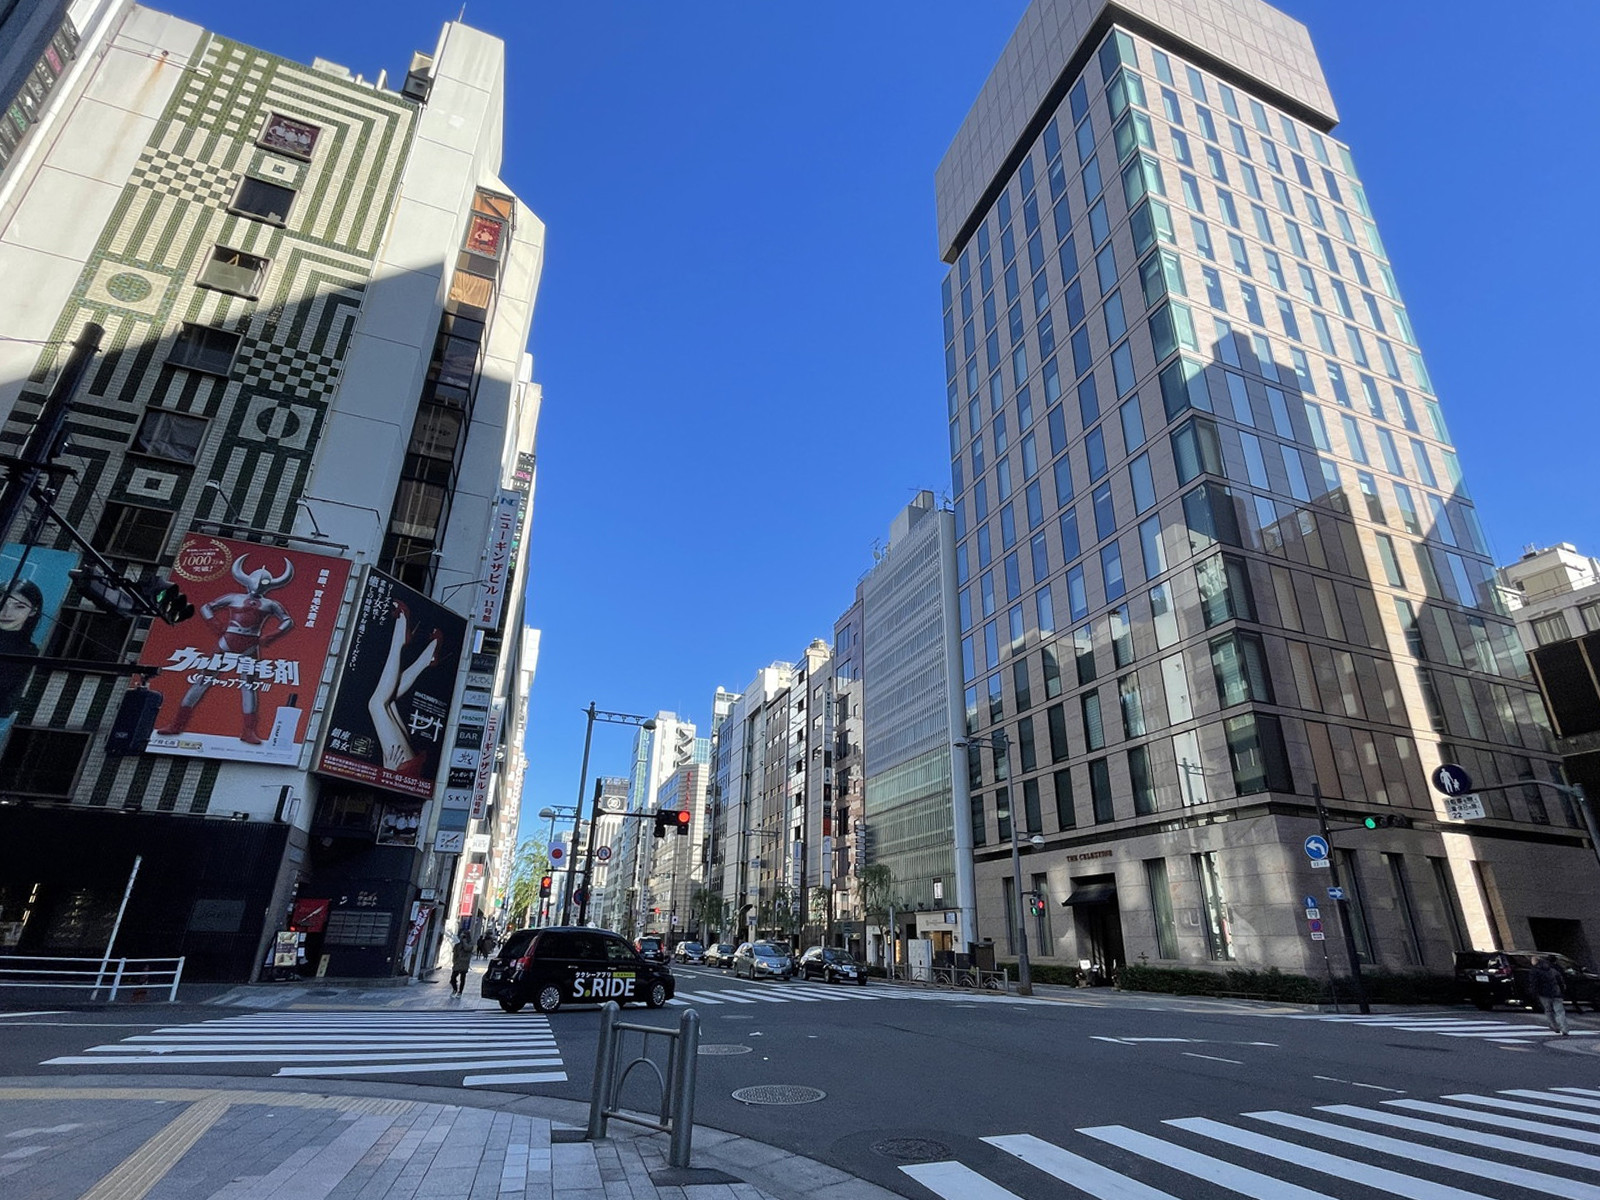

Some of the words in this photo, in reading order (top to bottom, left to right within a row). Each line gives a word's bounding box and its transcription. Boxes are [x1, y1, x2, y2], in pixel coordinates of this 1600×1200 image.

[486, 513, 511, 595] ニューギンザビル
[161, 646, 300, 686] ウルトラ育毛剤
[459, 731, 478, 741] BAR
[477, 717, 497, 790] ニューギンザビル
[447, 794, 468, 802] SKY
[573, 978, 636, 997] S.RIDE
